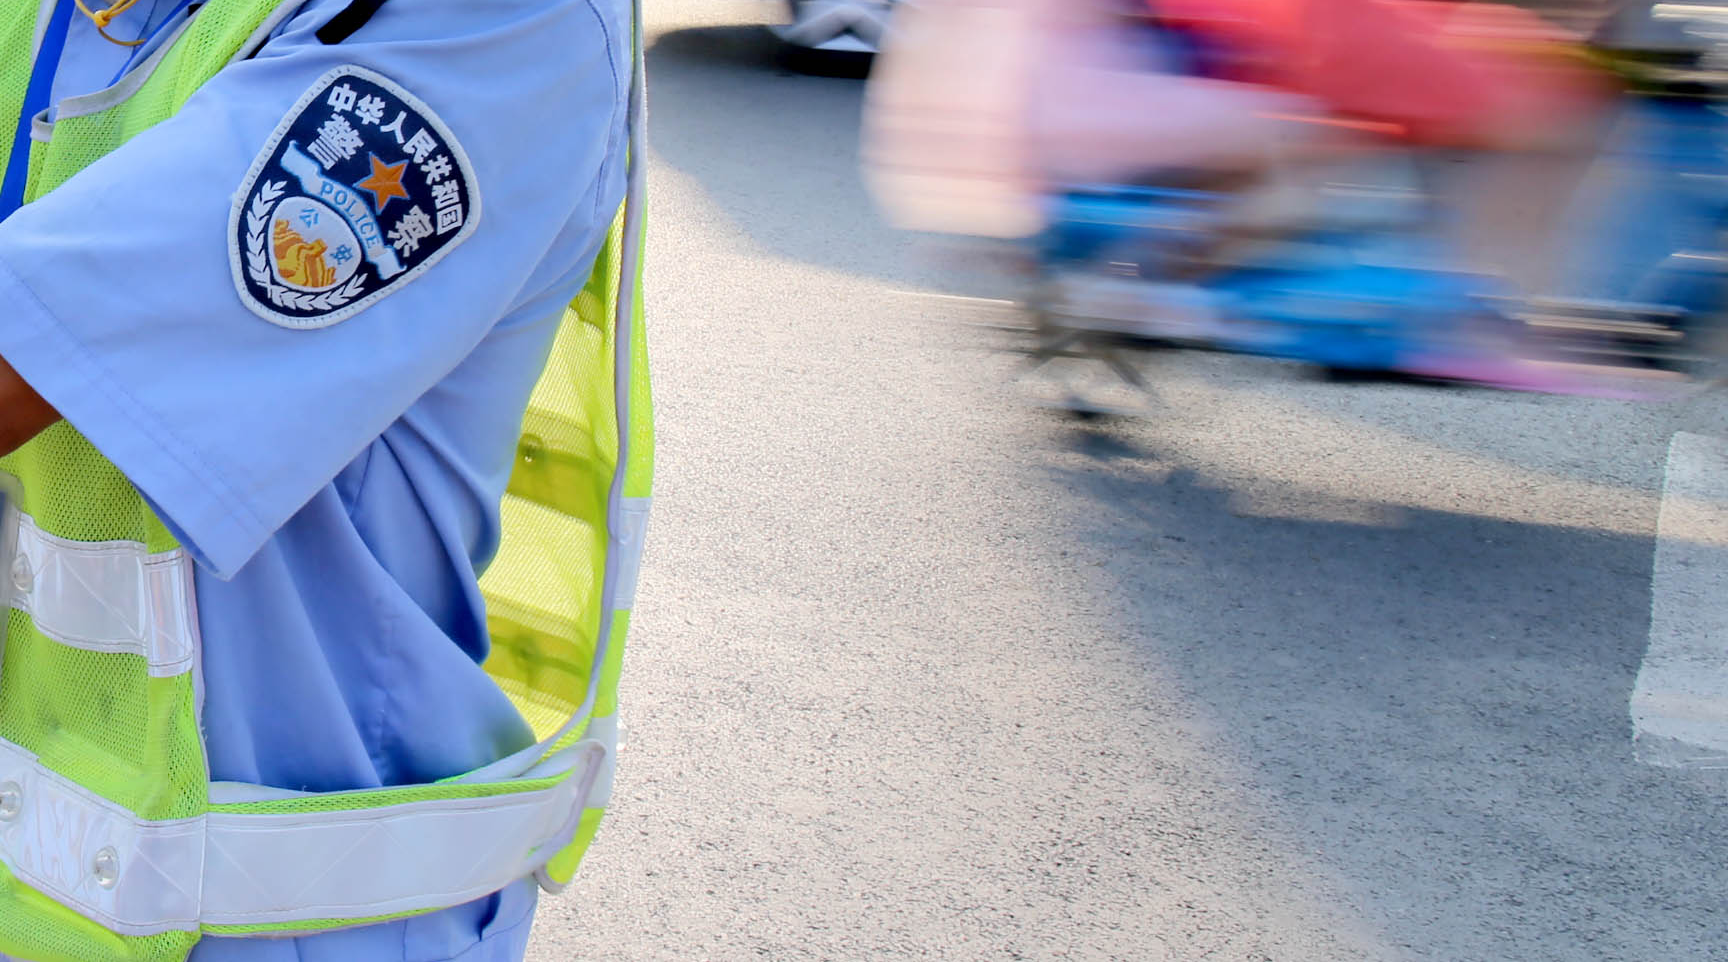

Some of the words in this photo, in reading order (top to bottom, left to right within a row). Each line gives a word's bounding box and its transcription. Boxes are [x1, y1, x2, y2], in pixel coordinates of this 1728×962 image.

[306, 111, 365, 171] 警
[387, 205, 435, 259] 察
[326, 83, 463, 235] 中华人民共和国
[298, 207, 320, 229] 公
[330, 244, 353, 266] 安
[319, 180, 382, 251] POLICE
